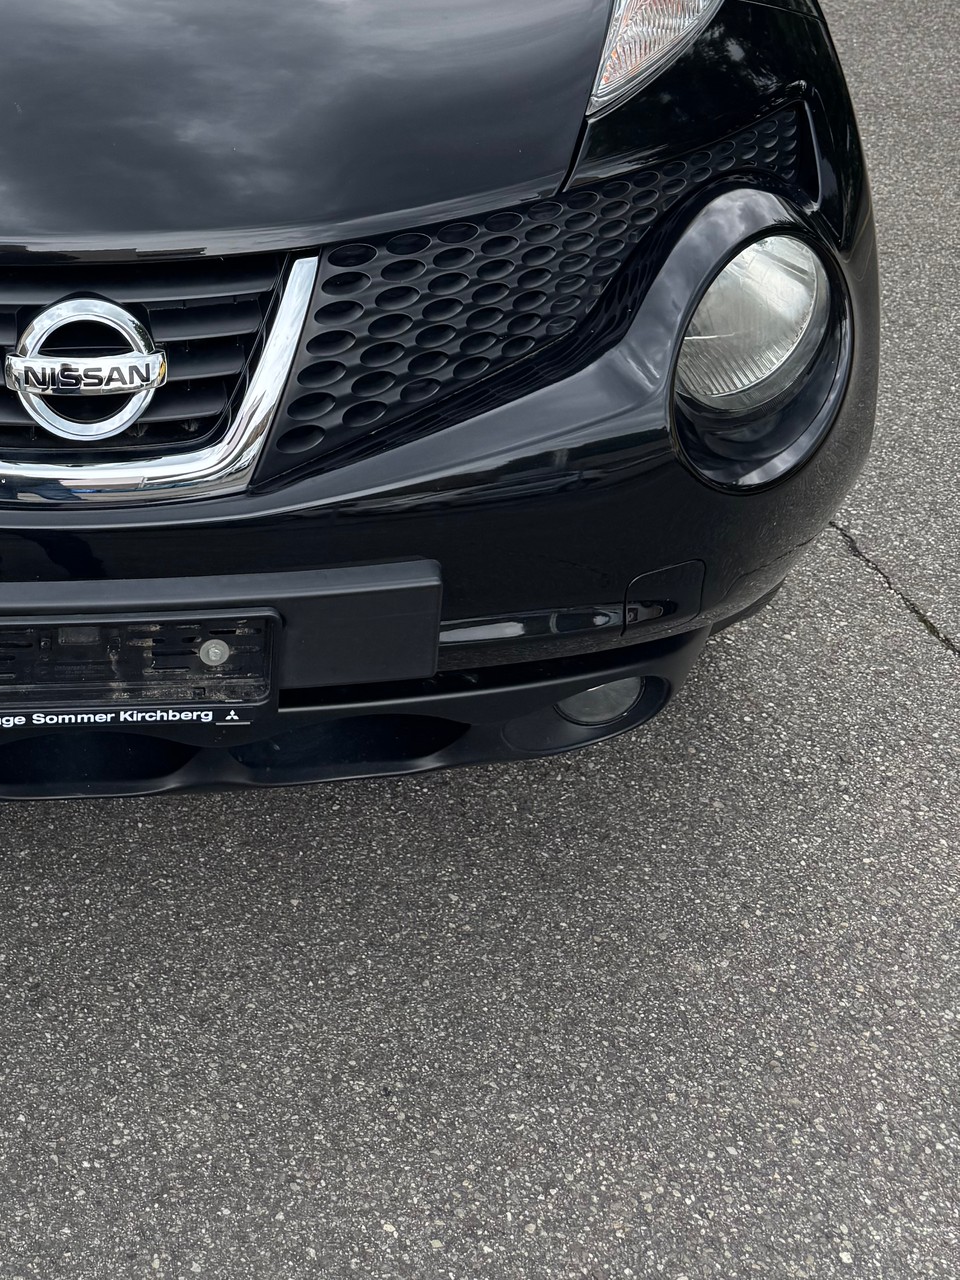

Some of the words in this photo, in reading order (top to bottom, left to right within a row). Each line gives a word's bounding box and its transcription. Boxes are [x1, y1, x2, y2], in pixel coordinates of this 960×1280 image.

[24, 362, 151, 389] NISSAN
[32, 712, 115, 724] Sommer
[119, 709, 213, 723] Kirchberg
